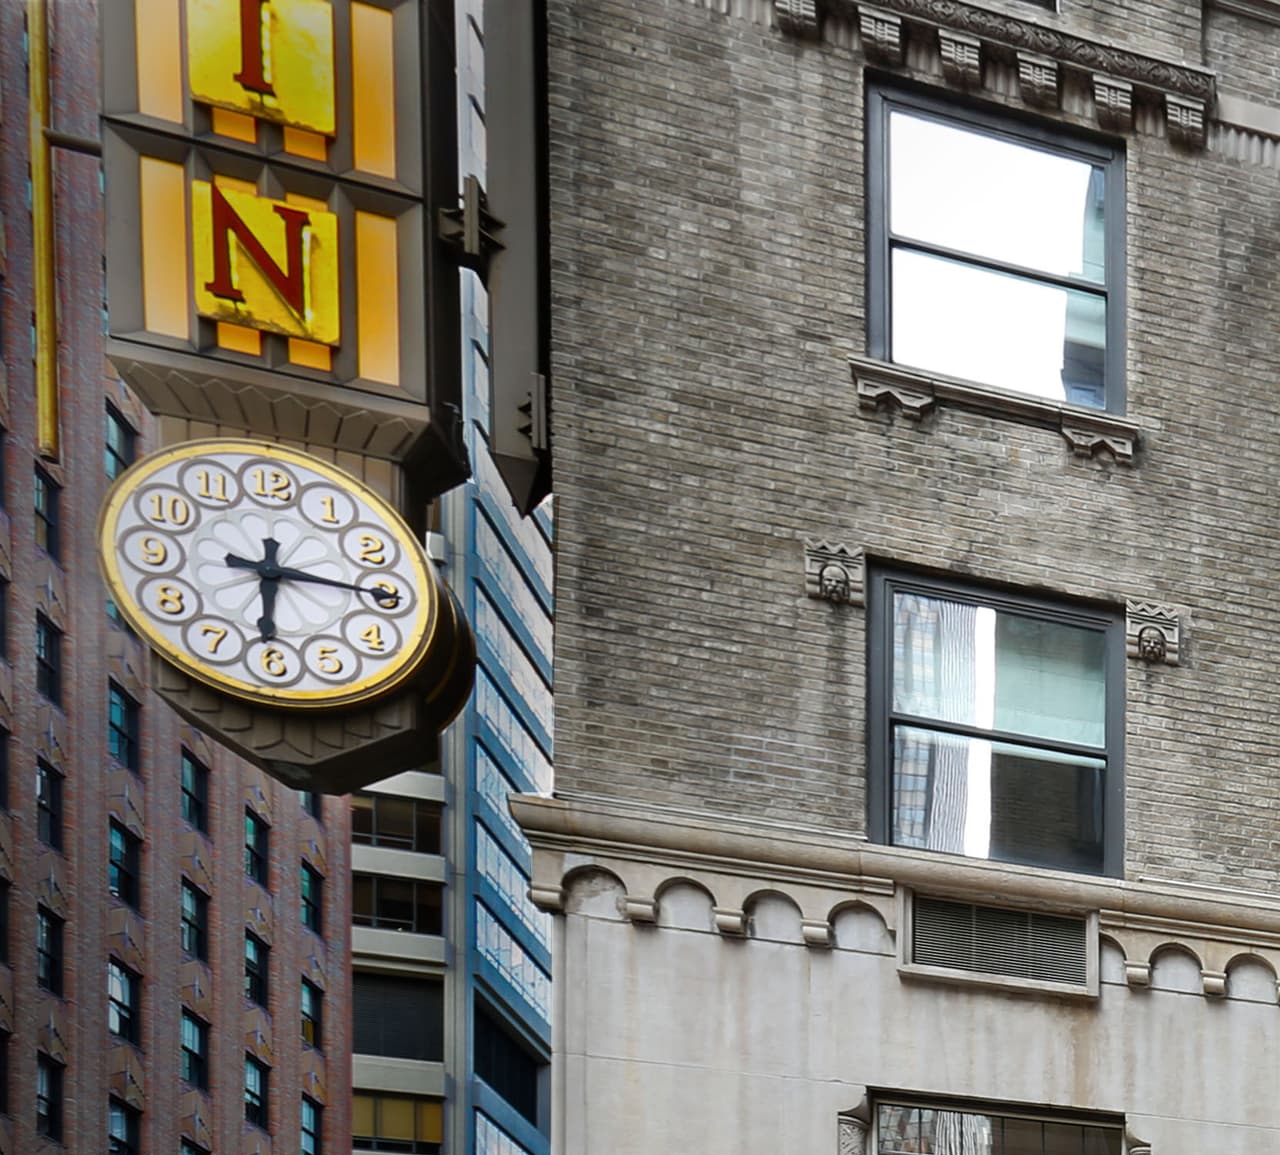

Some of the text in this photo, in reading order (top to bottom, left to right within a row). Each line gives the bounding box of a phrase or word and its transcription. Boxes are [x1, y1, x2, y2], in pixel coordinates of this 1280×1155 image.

[197, 470, 230, 502] 11
[253, 469, 291, 501] 12
[151, 494, 189, 525] 10
[321, 496, 341, 524] 1
[140, 537, 167, 565] 9
[359, 535, 385, 565] 2
[157, 584, 184, 614] 8
[200, 625, 227, 654] 7
[360, 624, 385, 651] 4
[260, 647, 287, 677] 6
[316, 646, 343, 674] 5
